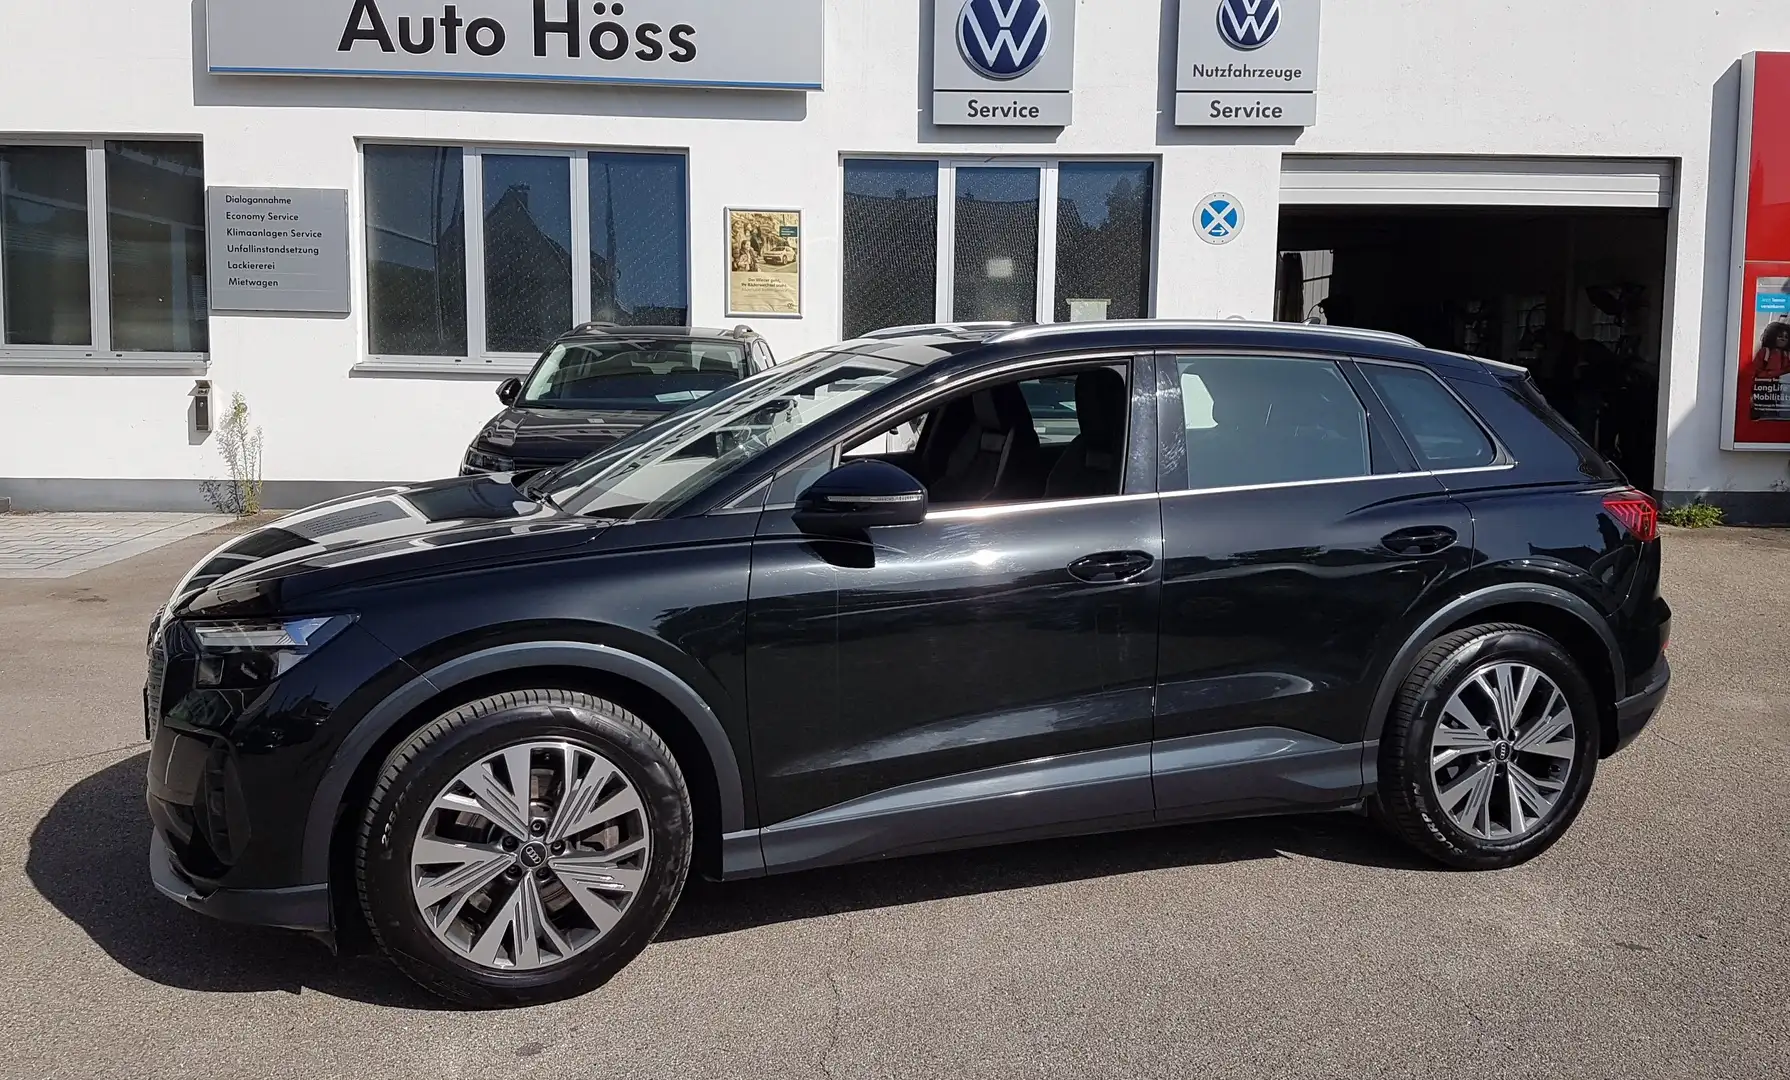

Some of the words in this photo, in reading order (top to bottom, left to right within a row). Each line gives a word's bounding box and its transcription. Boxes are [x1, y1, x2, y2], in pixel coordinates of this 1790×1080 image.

[336, 0, 506, 56] Auto
[532, 0, 697, 63] Höss
[1192, 63, 1302, 80] Nutzfahrzeuge
[967, 99, 1040, 119] Service
[1209, 99, 1283, 119] Service
[225, 195, 292, 205] Dialogannahme
[226, 212, 265, 221] Economy
[267, 212, 299, 221] Service
[226, 228, 288, 239] Klimaanlagen
[290, 229, 322, 238] Service
[227, 245, 319, 255] Unfallinstandsetzung
[227, 261, 275, 270] Lackiererei
[228, 278, 279, 288] Mietwagen
[1753, 384, 1788, 393] LongLife
